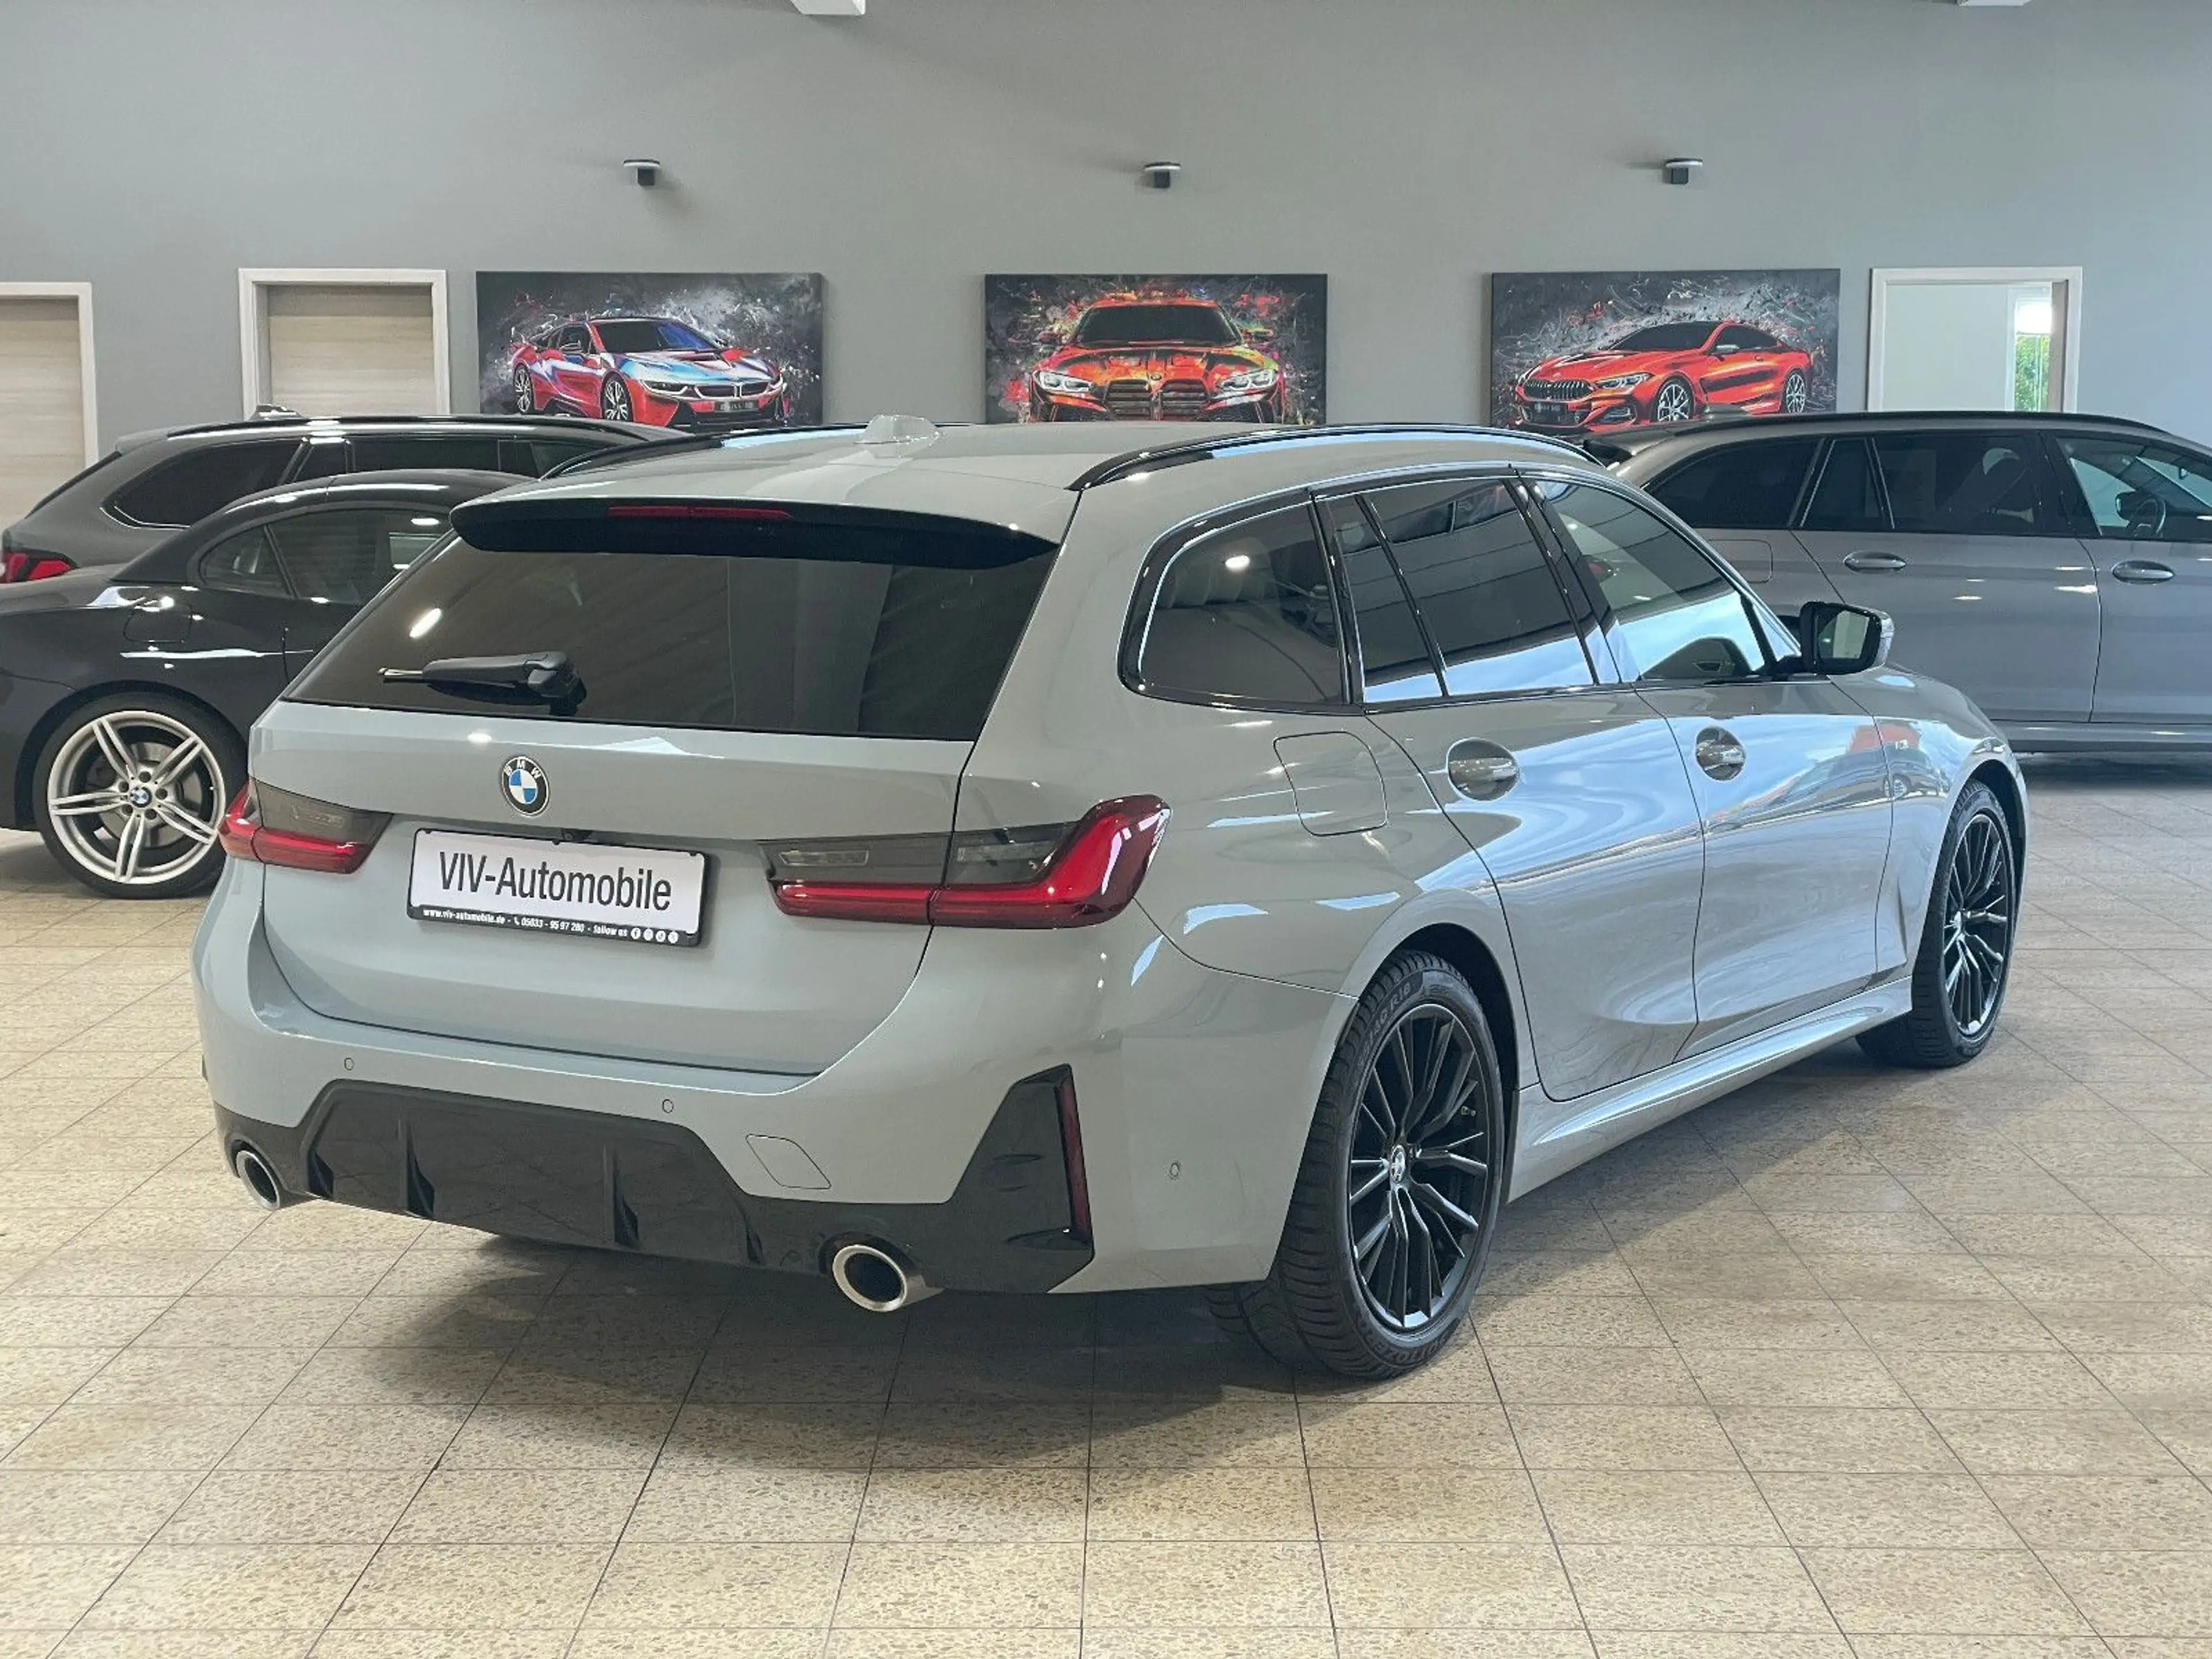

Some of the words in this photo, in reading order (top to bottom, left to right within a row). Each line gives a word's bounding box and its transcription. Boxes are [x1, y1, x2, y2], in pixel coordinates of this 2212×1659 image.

[503, 759, 542, 779] BMW
[440, 851, 672, 911] VIV-Automobile
[423, 909, 505, 925] www.viv-automobile.de
